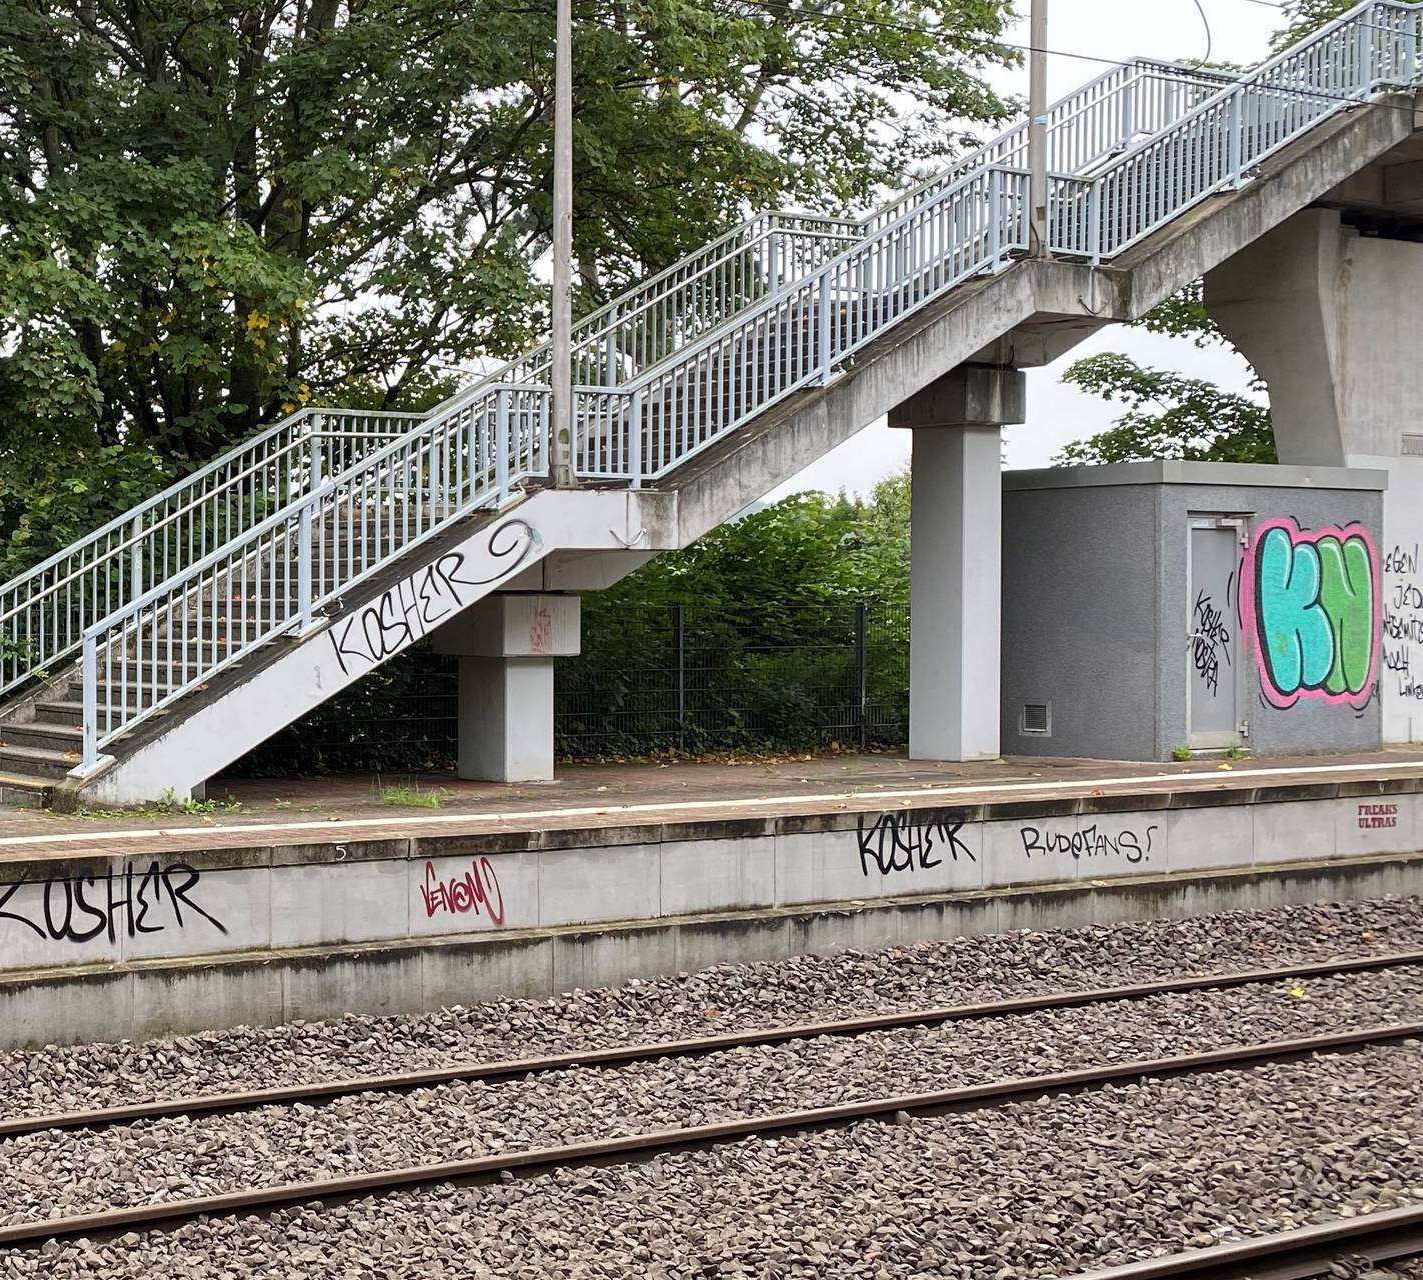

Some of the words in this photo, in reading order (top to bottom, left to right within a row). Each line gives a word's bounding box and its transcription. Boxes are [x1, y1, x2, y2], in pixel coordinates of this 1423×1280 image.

[328, 518, 534, 676] KOSHER
[1358, 804, 1398, 816] FREAKS
[1359, 817, 1397, 828] ULTRAS
[335, 845, 347, 861] 5
[857, 814, 976, 876] KOSHER
[420, 857, 504, 928] VENOM
